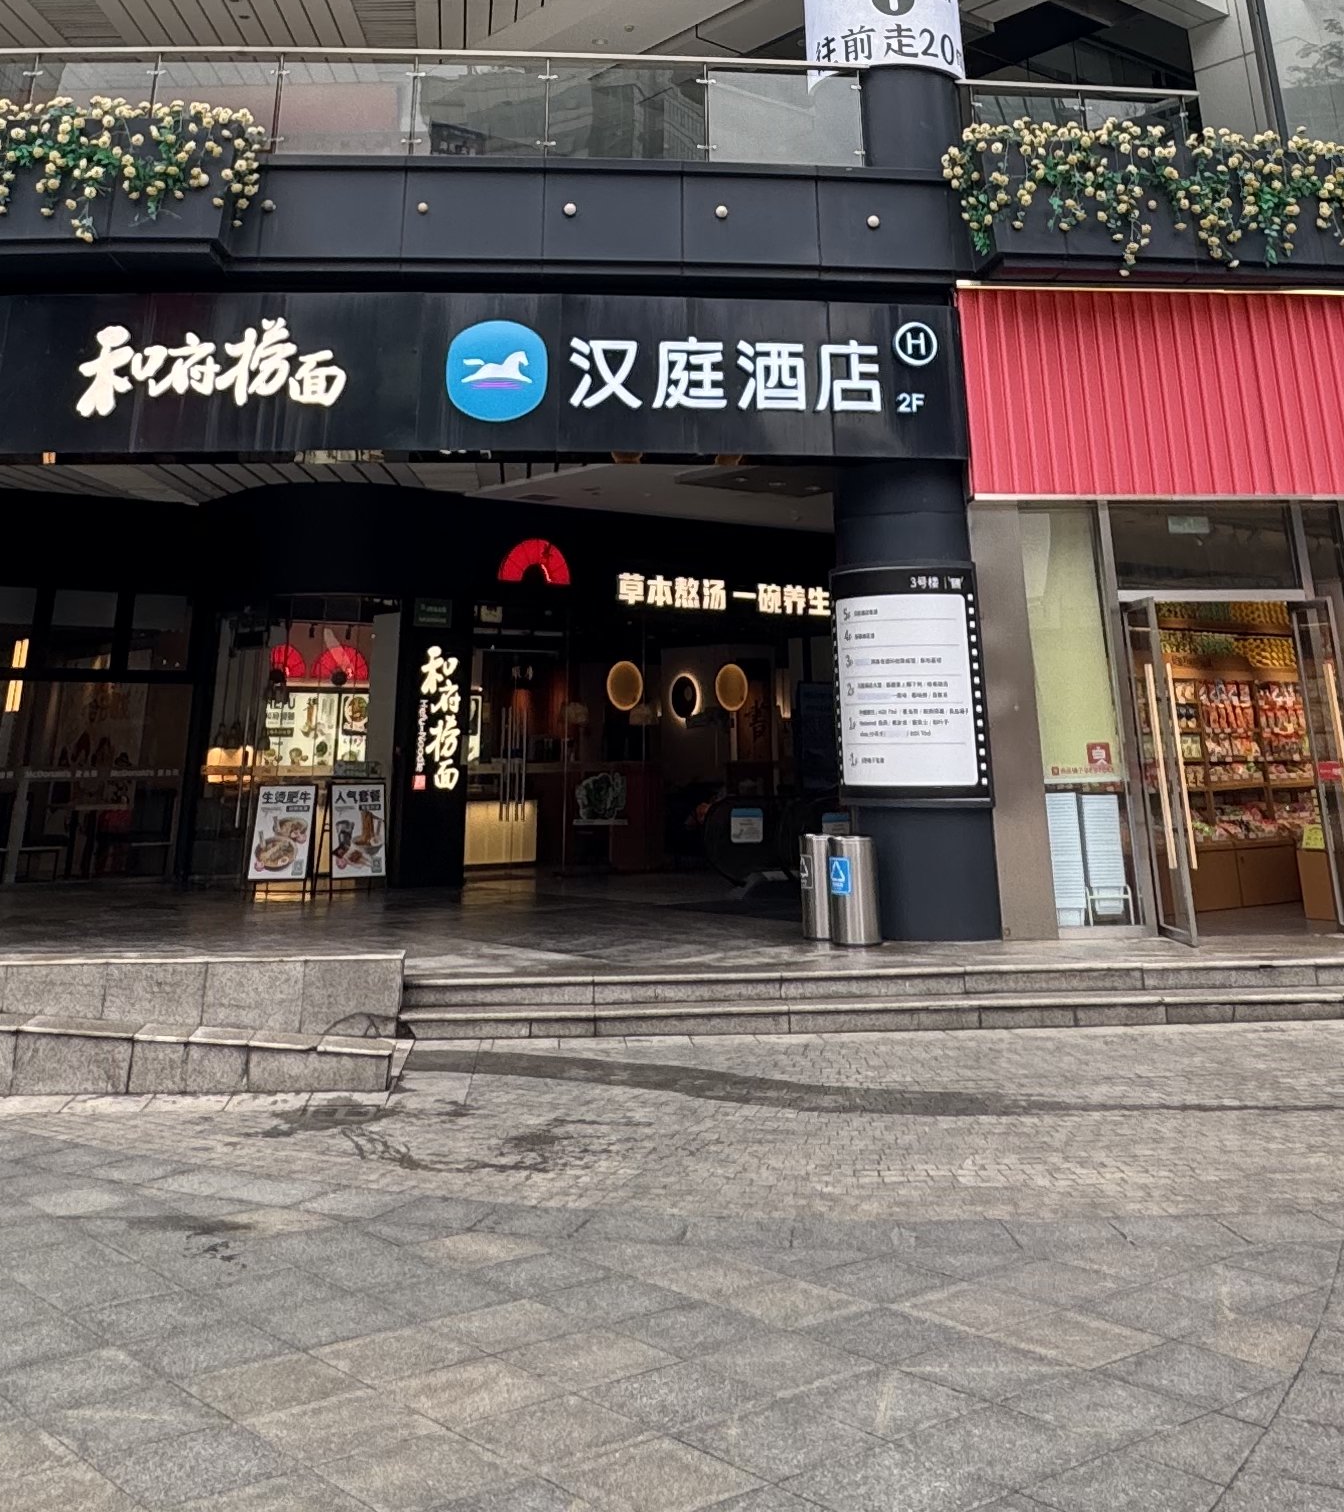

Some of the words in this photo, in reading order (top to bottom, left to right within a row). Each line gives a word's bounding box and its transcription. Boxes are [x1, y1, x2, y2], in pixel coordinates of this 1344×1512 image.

[75, 316, 347, 417] 和府捞面
[567, 337, 883, 412] 汉庭酒店
[896, 392, 925, 414] 2F
